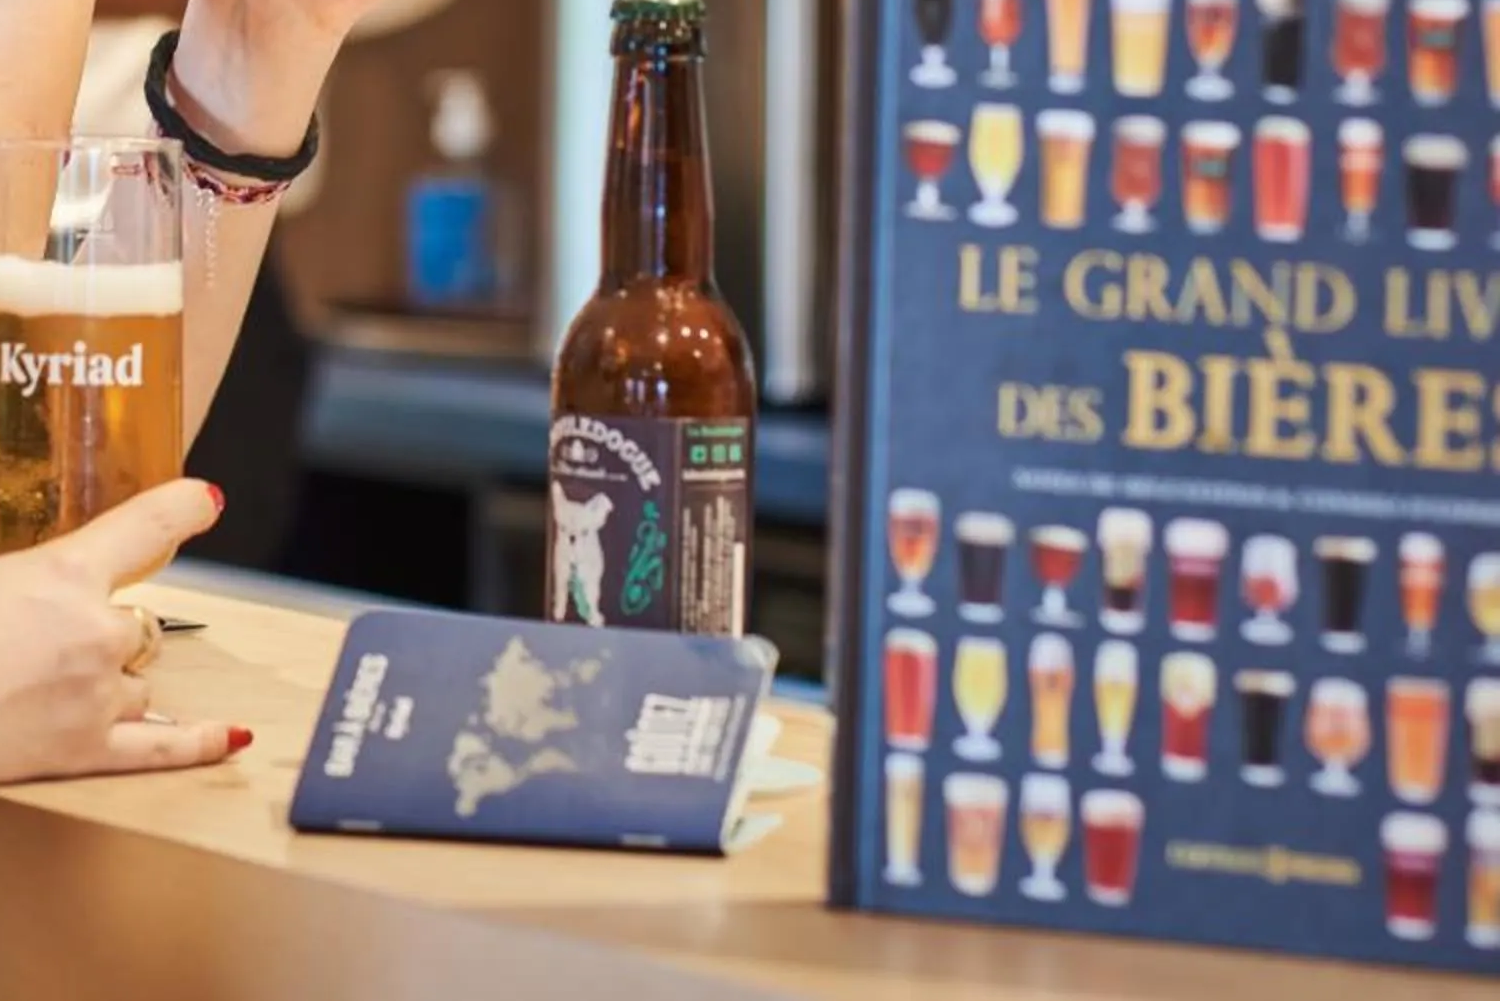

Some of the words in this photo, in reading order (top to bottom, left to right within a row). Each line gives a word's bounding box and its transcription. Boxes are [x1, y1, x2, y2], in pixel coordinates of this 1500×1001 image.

[959, 243, 1039, 314] LE
[1063, 248, 1357, 334] GRAND
[1383, 264, 1500, 343] LIV
[0, 341, 144, 397] Kyriad
[998, 383, 1104, 442] DES
[1121, 321, 1500, 474] BIÈRE
